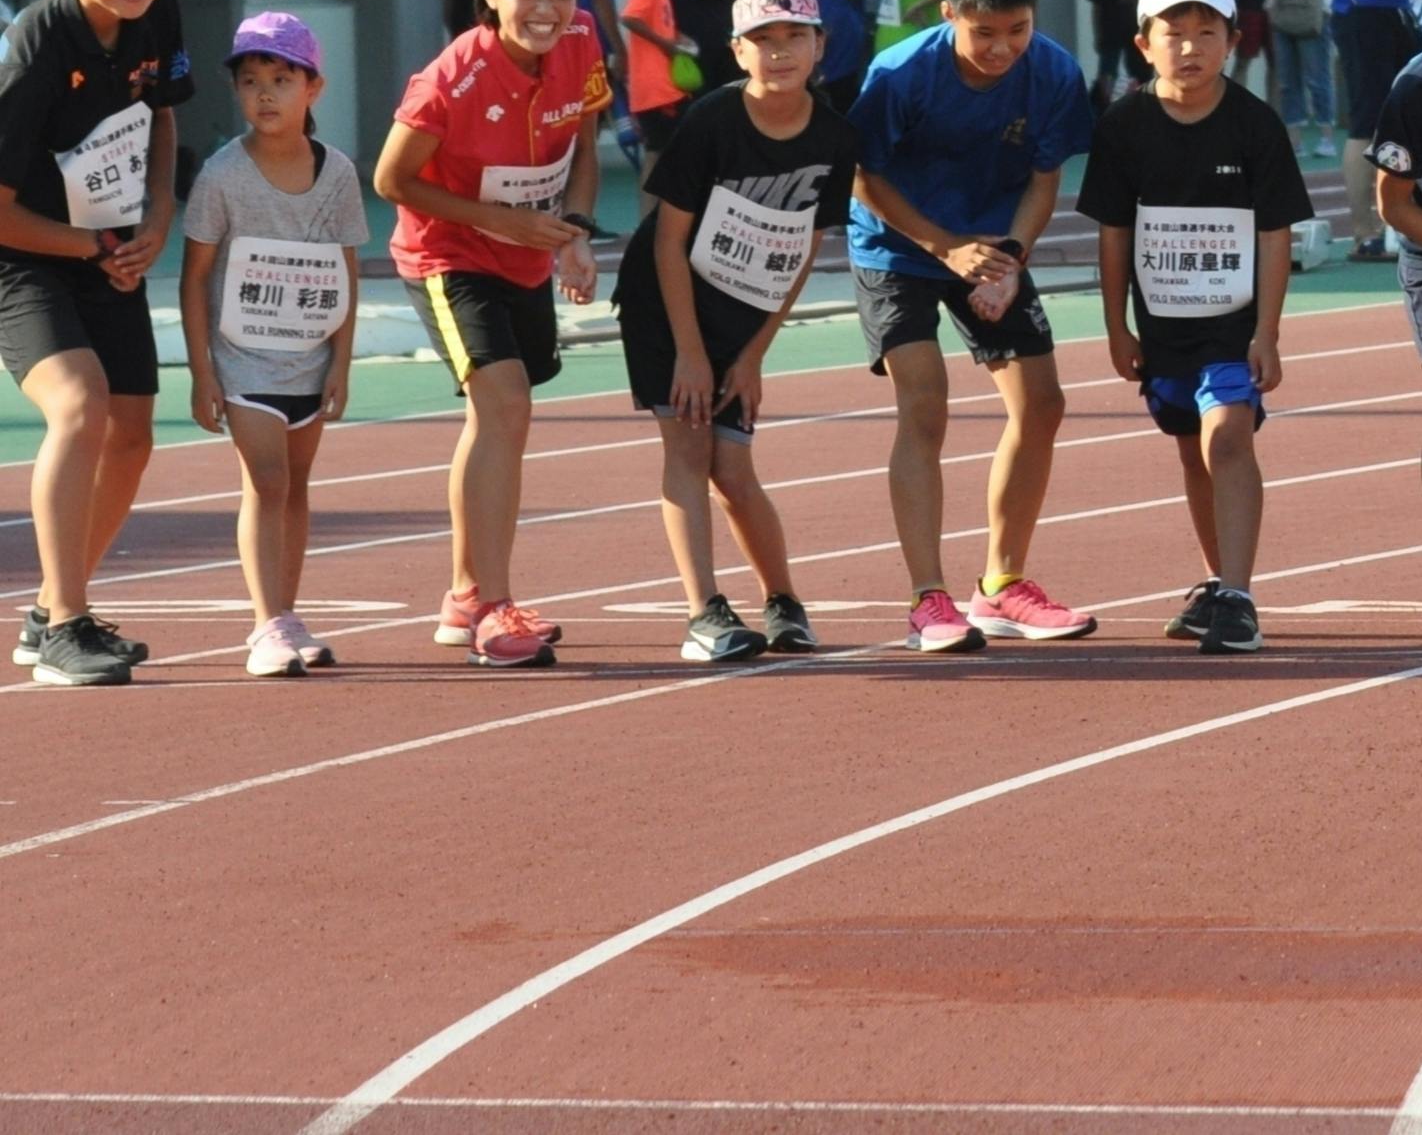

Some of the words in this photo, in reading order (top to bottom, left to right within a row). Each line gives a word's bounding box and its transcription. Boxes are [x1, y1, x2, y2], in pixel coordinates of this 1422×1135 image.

[84, 164, 121, 193] 谷口
[711, 231, 754, 265] 樽川
[1143, 238, 1237, 250] CHALLENGER
[1142, 250, 1241, 272] 大川原皇輝
[245, 268, 337, 285] CHALLENGER
[239, 281, 284, 307] 樽川
[296, 288, 339, 310] 彩那
[1170, 295, 1207, 305] RUNNING
[1209, 295, 1232, 304] CLUB
[267, 326, 304, 339] RUNNING
